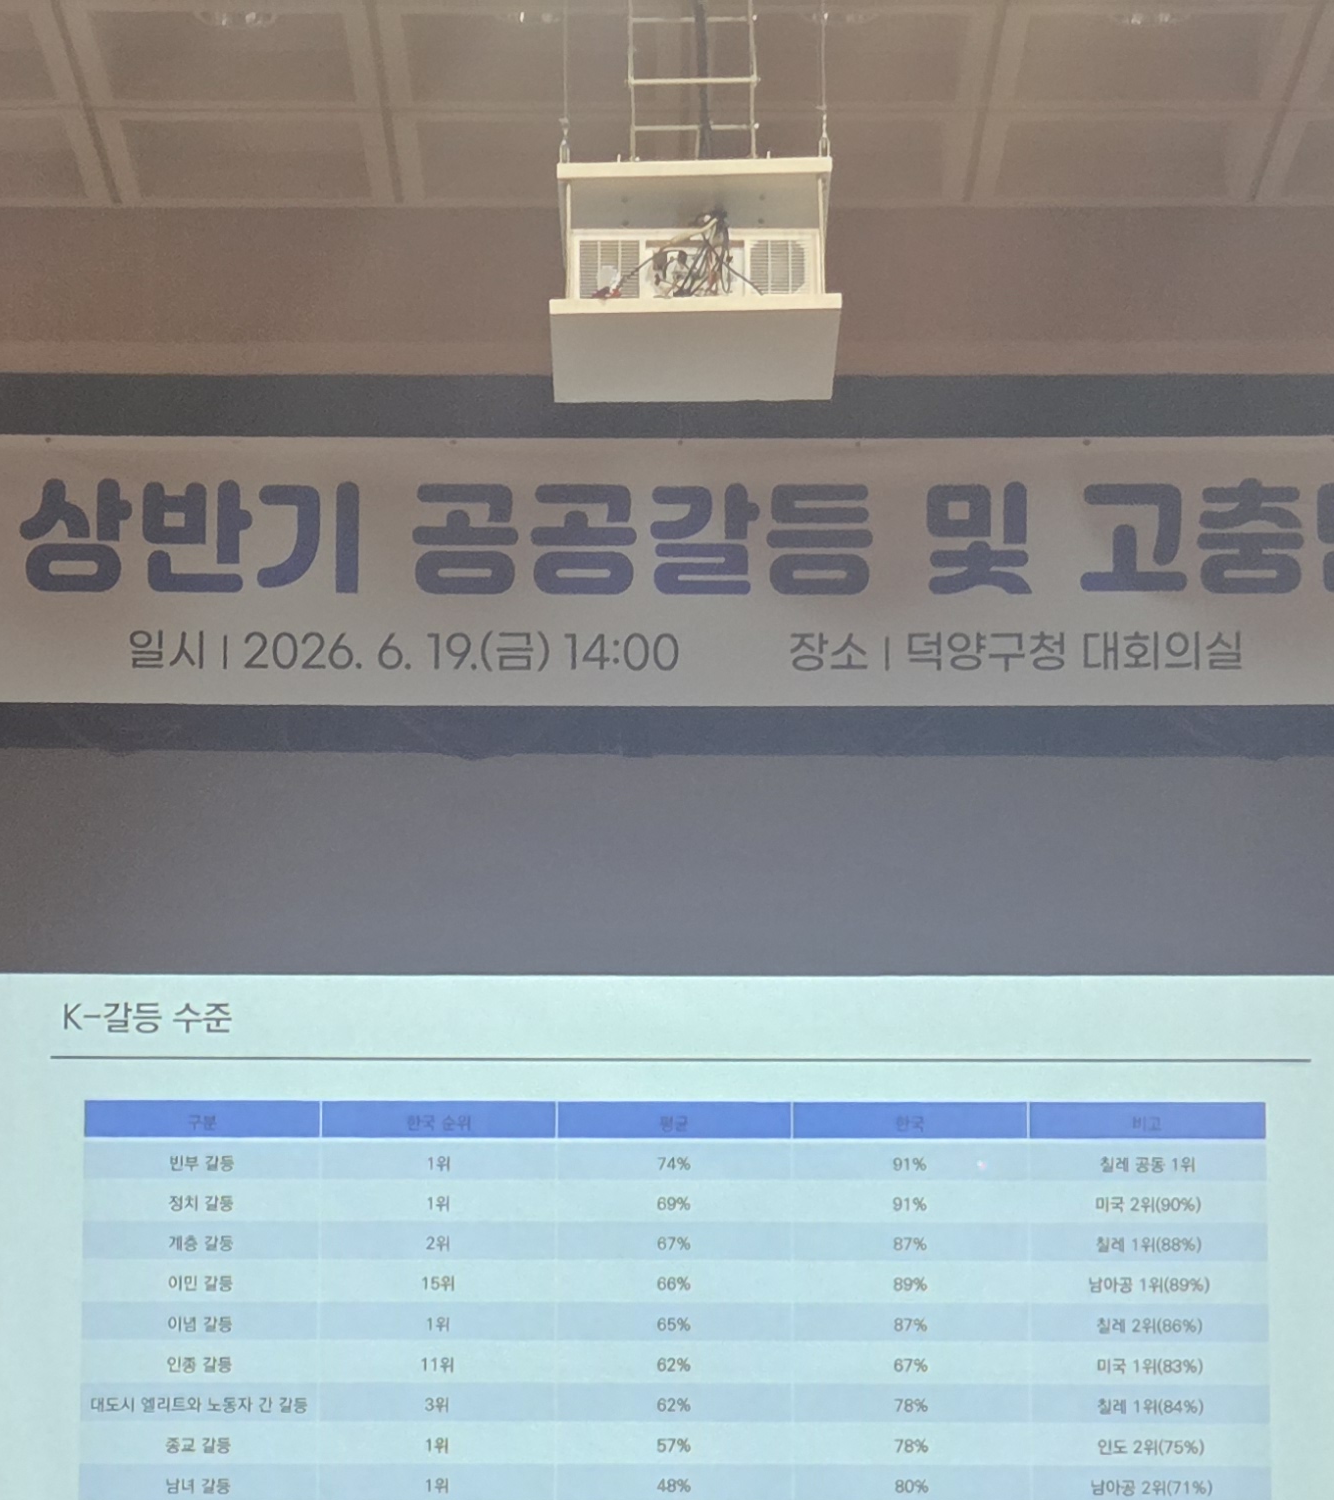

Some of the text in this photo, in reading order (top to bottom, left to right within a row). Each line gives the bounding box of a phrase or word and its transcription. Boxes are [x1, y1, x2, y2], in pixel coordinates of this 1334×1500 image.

[18, 477, 361, 595] 상반기
[411, 482, 874, 596] 공공갈등
[925, 480, 1033, 595] 및
[129, 629, 205, 670] 일시
[243, 630, 363, 670] 2026.
[377, 632, 412, 671] 6.
[426, 630, 550, 673] 19.(금)
[564, 632, 679, 672] 14:00
[789, 631, 869, 672] 장소
[907, 630, 1066, 673] 덕양구청
[1082, 630, 1243, 671] 대회의실
[63, 1001, 233, 1034] K-갈등 수준
[187, 1114, 217, 1132] 구분
[406, 1114, 472, 1132] 한국 순위
[169, 1154, 235, 1173] 빈부 갈등
[427, 1155, 451, 1172] 1위
[657, 1156, 692, 1171] 74%
[892, 1156, 928, 1172] 91%
[1099, 1155, 1196, 1174] 칠레 공동 1위
[168, 1194, 234, 1213] 정치 갈등
[427, 1195, 450, 1213] 1위
[656, 1196, 691, 1212] 69%
[892, 1196, 928, 1213] 91%
[1095, 1196, 1202, 1214] 미국 2위(90%)
[204, 1234, 234, 1253] 갈등
[425, 1235, 450, 1252] 2위
[656, 1235, 692, 1251] 67%
[892, 1236, 928, 1252] 87%
[1095, 1236, 1202, 1254] 칠레 1위(88%)
[168, 1274, 234, 1293] 이민 갈등
[421, 1274, 455, 1292] 15위
[656, 1275, 692, 1292] 66%
[892, 1276, 929, 1293] 89%
[1088, 1276, 1211, 1295] 남아공 1위(89%)
[167, 1315, 233, 1334] 이념 갈등
[426, 1316, 450, 1333] 1위
[656, 1316, 692, 1332] 65%
[893, 1317, 928, 1333] 87%
[1096, 1317, 1203, 1335] 칠레 2위(86%)
[166, 1355, 233, 1374] 인종 갈등
[420, 1356, 455, 1374] 11위
[656, 1356, 692, 1373] 62%
[893, 1357, 929, 1373] 67%
[1096, 1357, 1204, 1376] 미국 1위(83%)
[90, 1396, 308, 1415] 대도시 엘리트와 노동자 간 갈등
[424, 1396, 450, 1414] 3위
[656, 1397, 692, 1413] 62%
[894, 1397, 929, 1414] 78%
[1097, 1397, 1204, 1417] 칠레 1위(84%)
[165, 1436, 232, 1455] 종교 갈등
[425, 1436, 449, 1455] 1위
[656, 1437, 692, 1454] 57%
[894, 1437, 930, 1454] 78%
[1097, 1438, 1205, 1457] 인도 2위(75%)
[165, 1477, 231, 1495] 남녀 갈등
[425, 1477, 449, 1494] 1위
[656, 1478, 692, 1494] 48%
[894, 1478, 930, 1494] 80%
[1090, 1479, 1213, 1498] 남아공 2위(71%)
